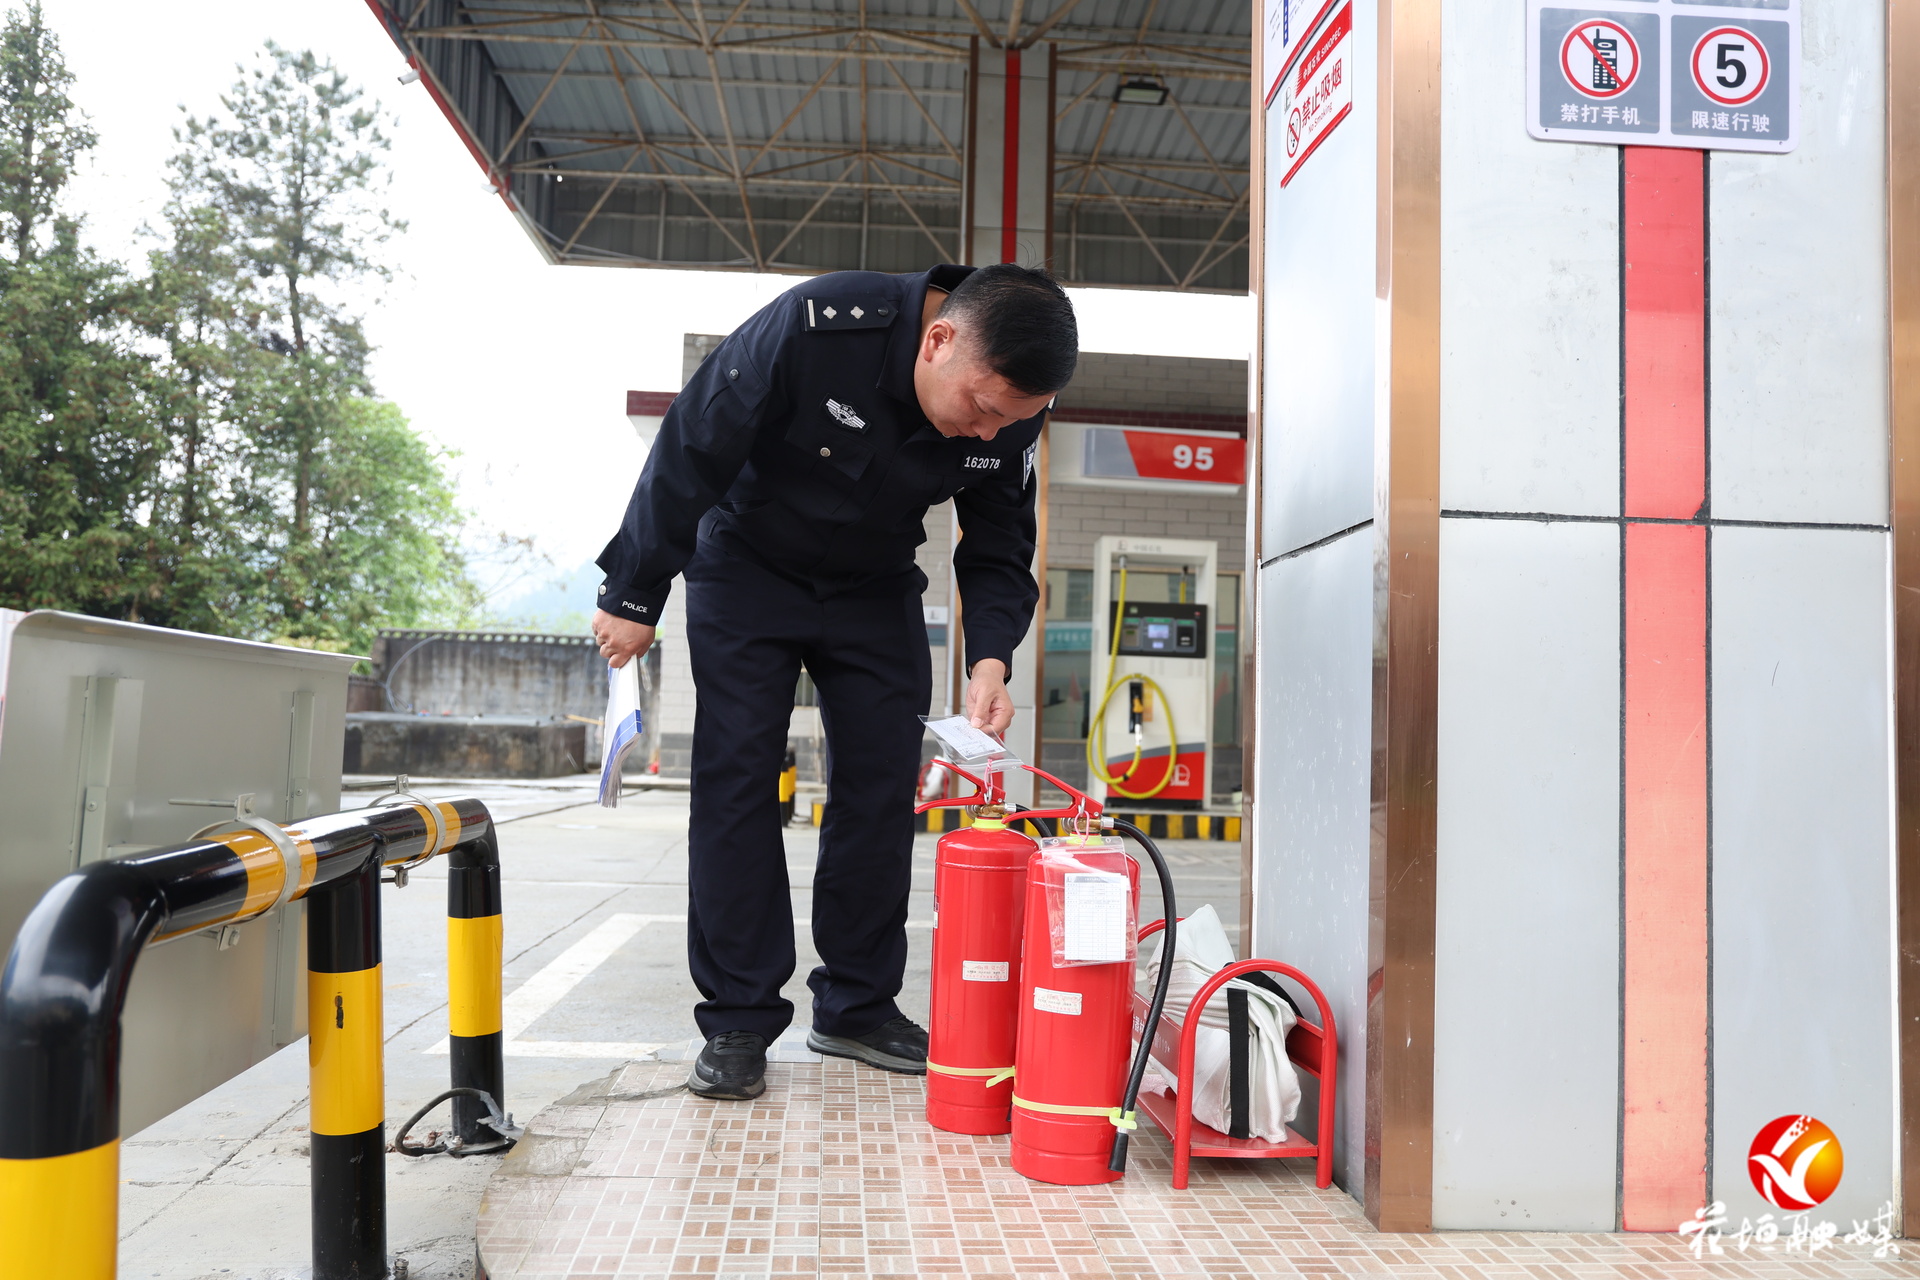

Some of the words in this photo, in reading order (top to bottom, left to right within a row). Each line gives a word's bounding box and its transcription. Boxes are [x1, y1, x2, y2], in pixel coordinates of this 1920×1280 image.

[1321, 27, 1342, 57] SINOPEC
[1716, 43, 1747, 88] 5
[1302, 58, 1342, 127] 禁止吸烟
[1560, 103, 1640, 126] 禁打手机
[1692, 110, 1770, 133] 限速行驶
[964, 456, 1001, 470] 162078
[1173, 444, 1214, 471] 95
[622, 601, 648, 613] POLICE
